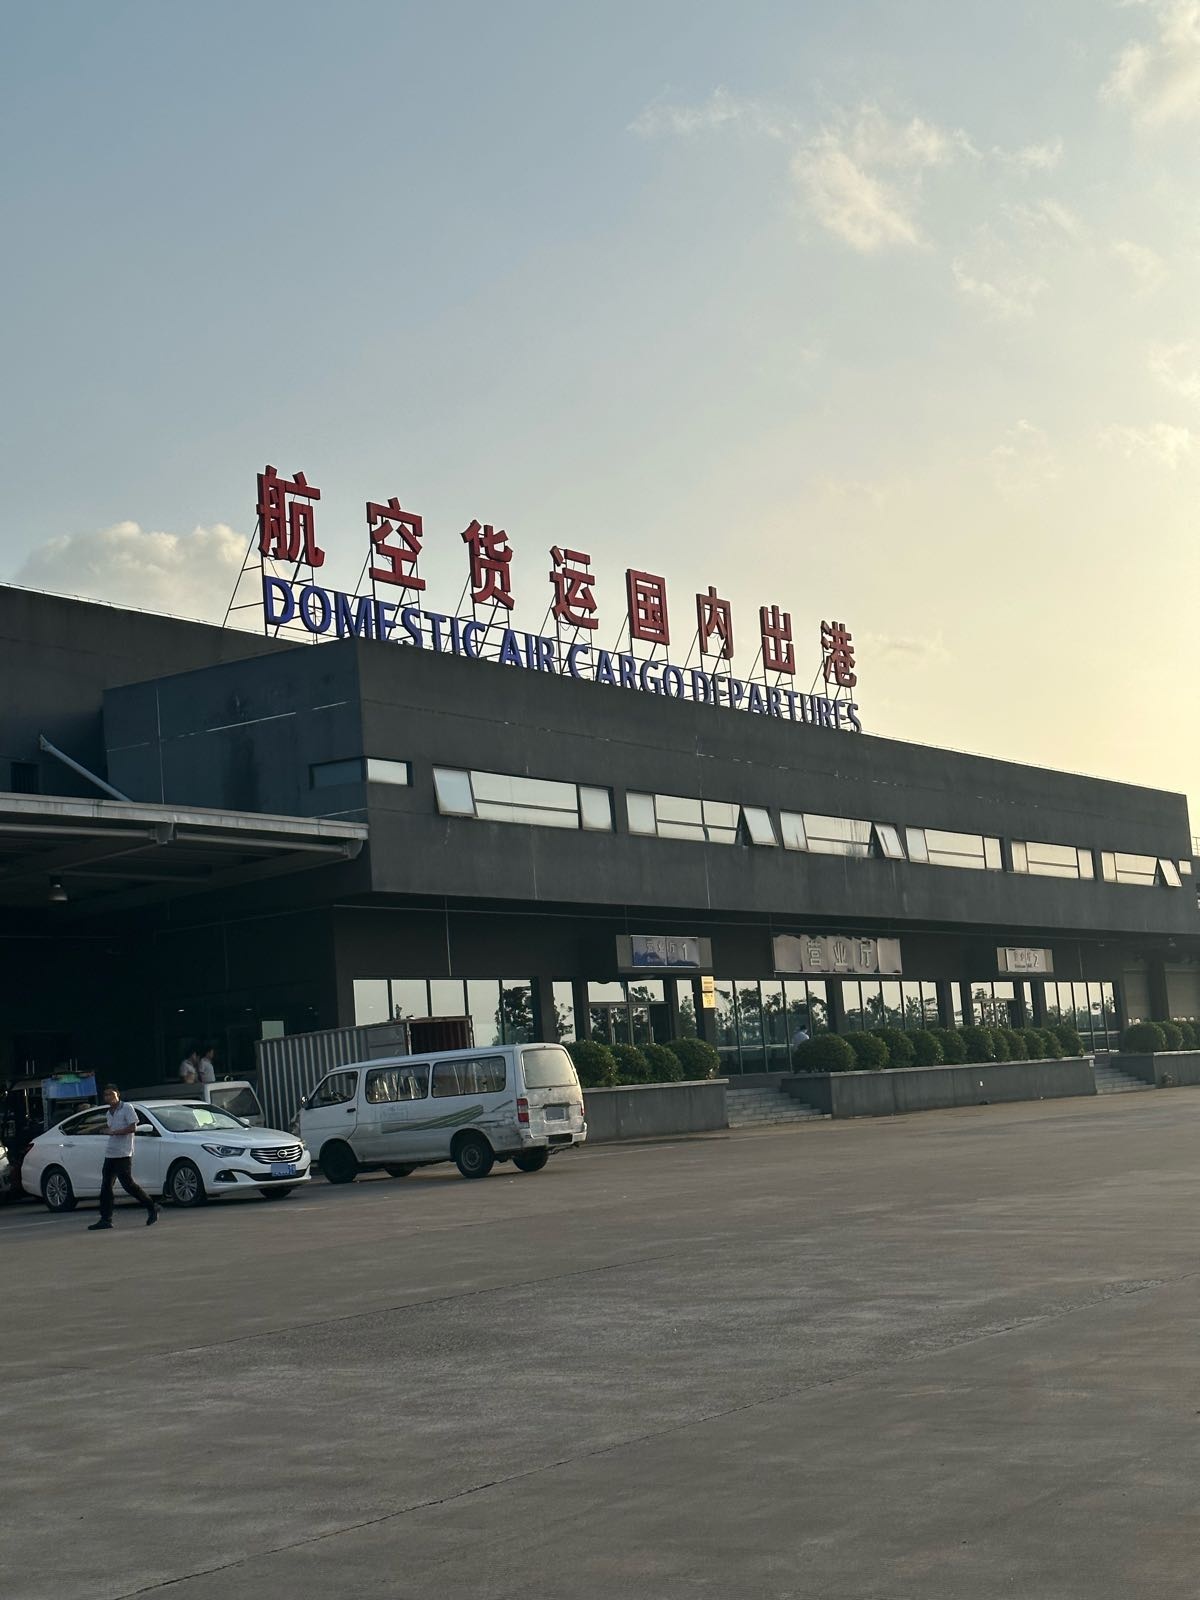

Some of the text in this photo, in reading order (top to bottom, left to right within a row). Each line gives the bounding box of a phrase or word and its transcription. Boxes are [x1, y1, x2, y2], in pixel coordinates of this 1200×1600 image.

[256, 465, 857, 688] 航空货运国内出港
[263, 575, 863, 734] DOMESTIC AIR CARGO DEPARTURES
[806, 940, 872, 969] 营业厅
